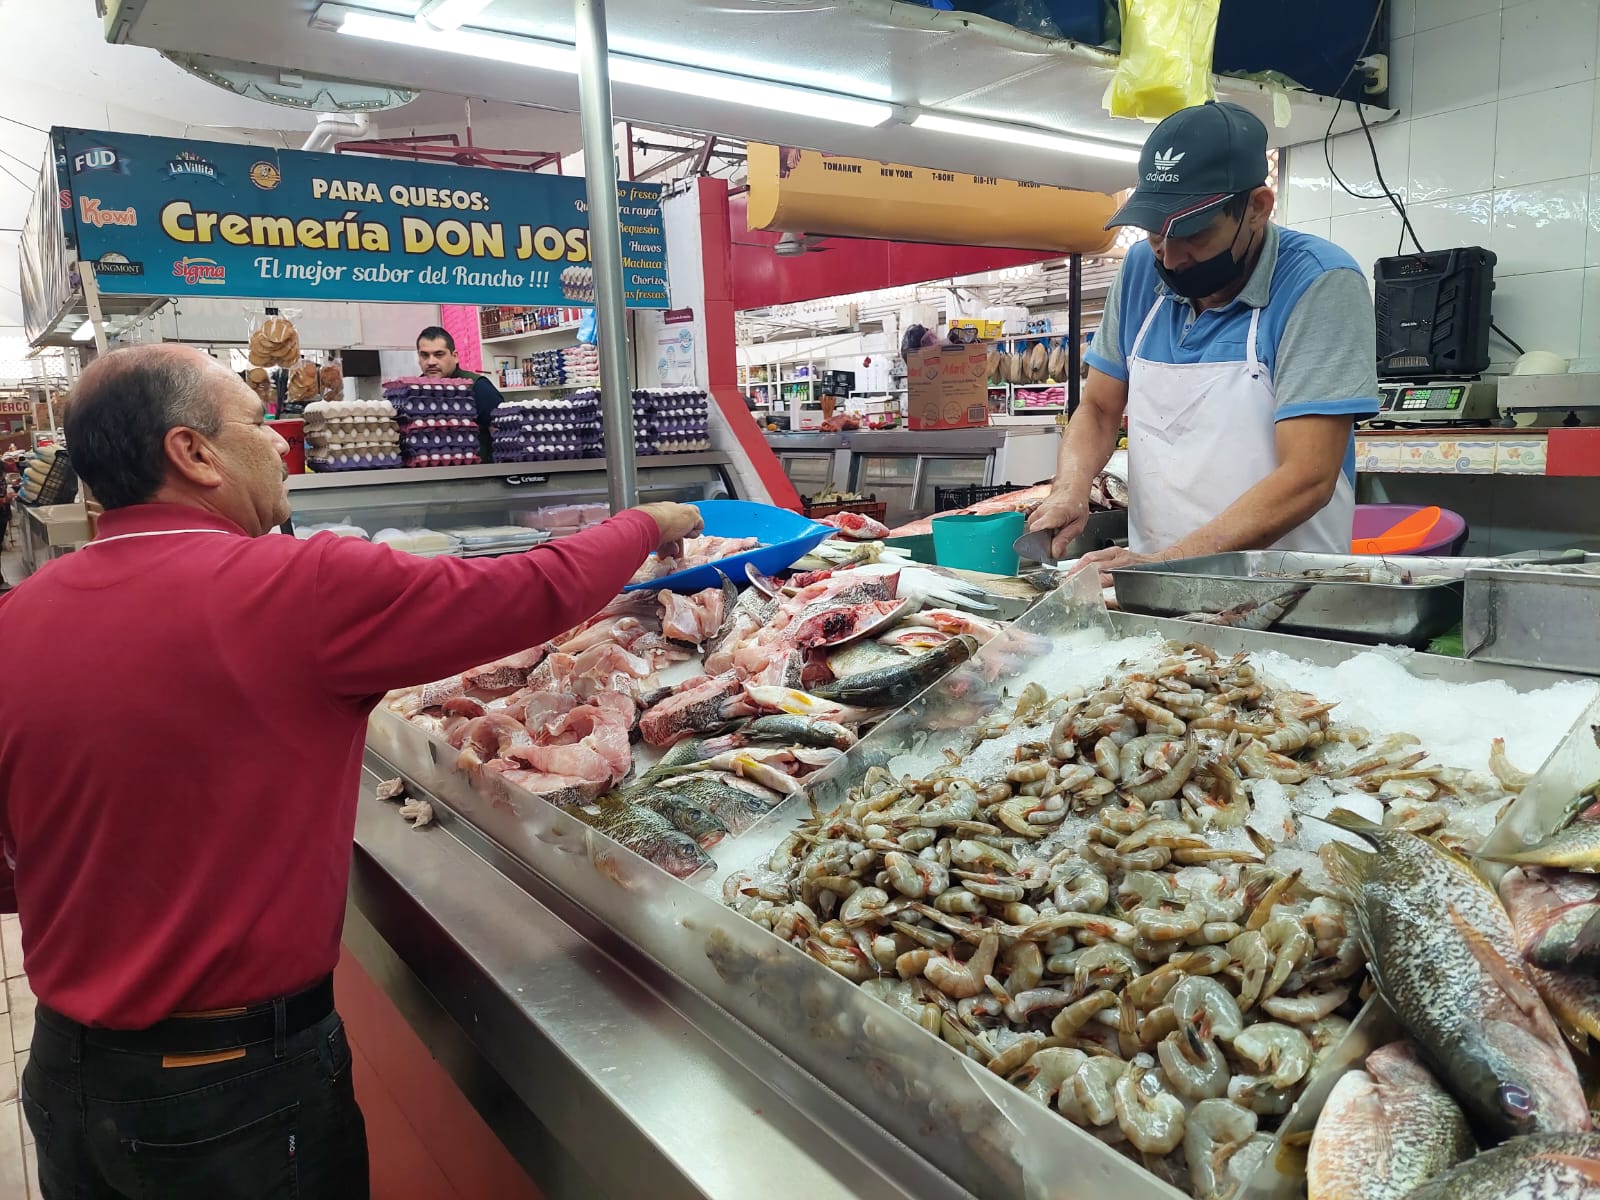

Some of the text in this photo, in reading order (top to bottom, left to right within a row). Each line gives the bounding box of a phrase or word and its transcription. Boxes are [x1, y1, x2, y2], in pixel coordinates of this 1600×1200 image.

[75, 150, 116, 172] FUD
[823, 161, 862, 174] TOMAHAWK
[170, 162, 214, 177] La Villita
[880, 168, 913, 179] NEW YORK
[932, 172, 955, 182] T-BONE
[1145, 172, 1180, 183] adidas
[312, 178, 490, 212] PARA QUESOS:
[630, 188, 658, 201] fresco
[80, 196, 137, 228] Kowi
[631, 206, 659, 218] rayar
[161, 200, 391, 252] Cremería
[402, 217, 505, 259] DON
[629, 241, 662, 252] Huevos
[622, 256, 662, 269] Machaca
[173, 260, 226, 285] Sigma
[253, 256, 550, 288] El mejor sabor del Rancho !!!
[631, 274, 664, 285] Chorizo
[635, 288, 666, 303] frescas
[0, 402, 29, 412] ERCO
